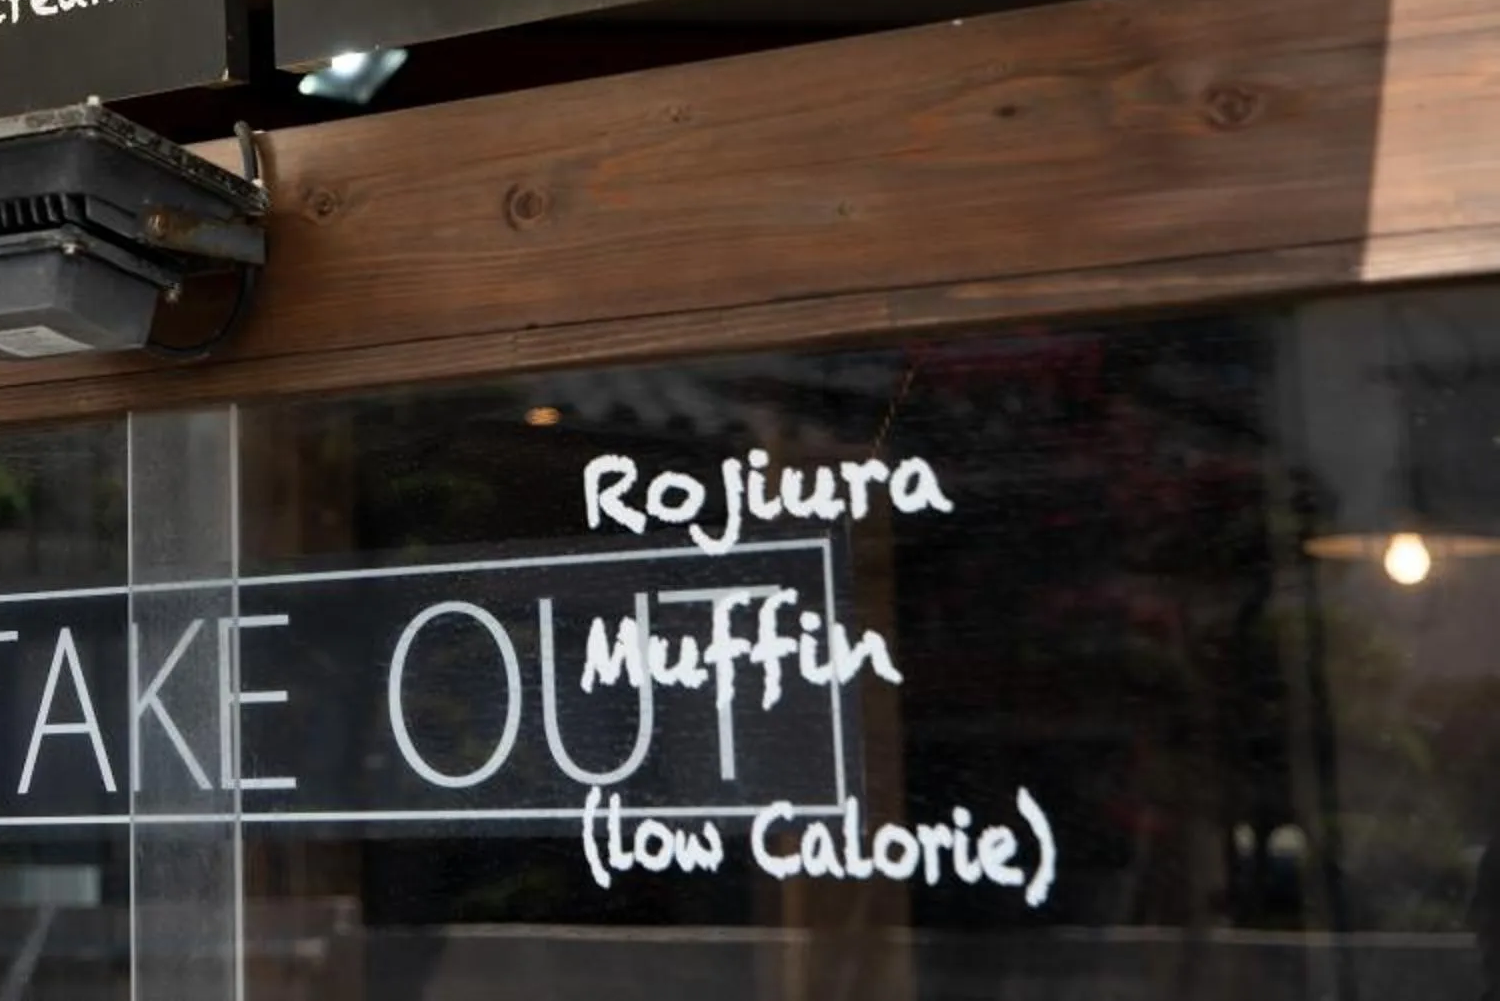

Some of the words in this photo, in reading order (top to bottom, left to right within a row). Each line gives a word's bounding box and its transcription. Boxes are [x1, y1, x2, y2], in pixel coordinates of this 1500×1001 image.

[584, 449, 954, 556] Rojiura
[386, 584, 782, 789] OUT
[581, 587, 904, 712] Muffin
[751, 786, 1056, 907] Calorie)
